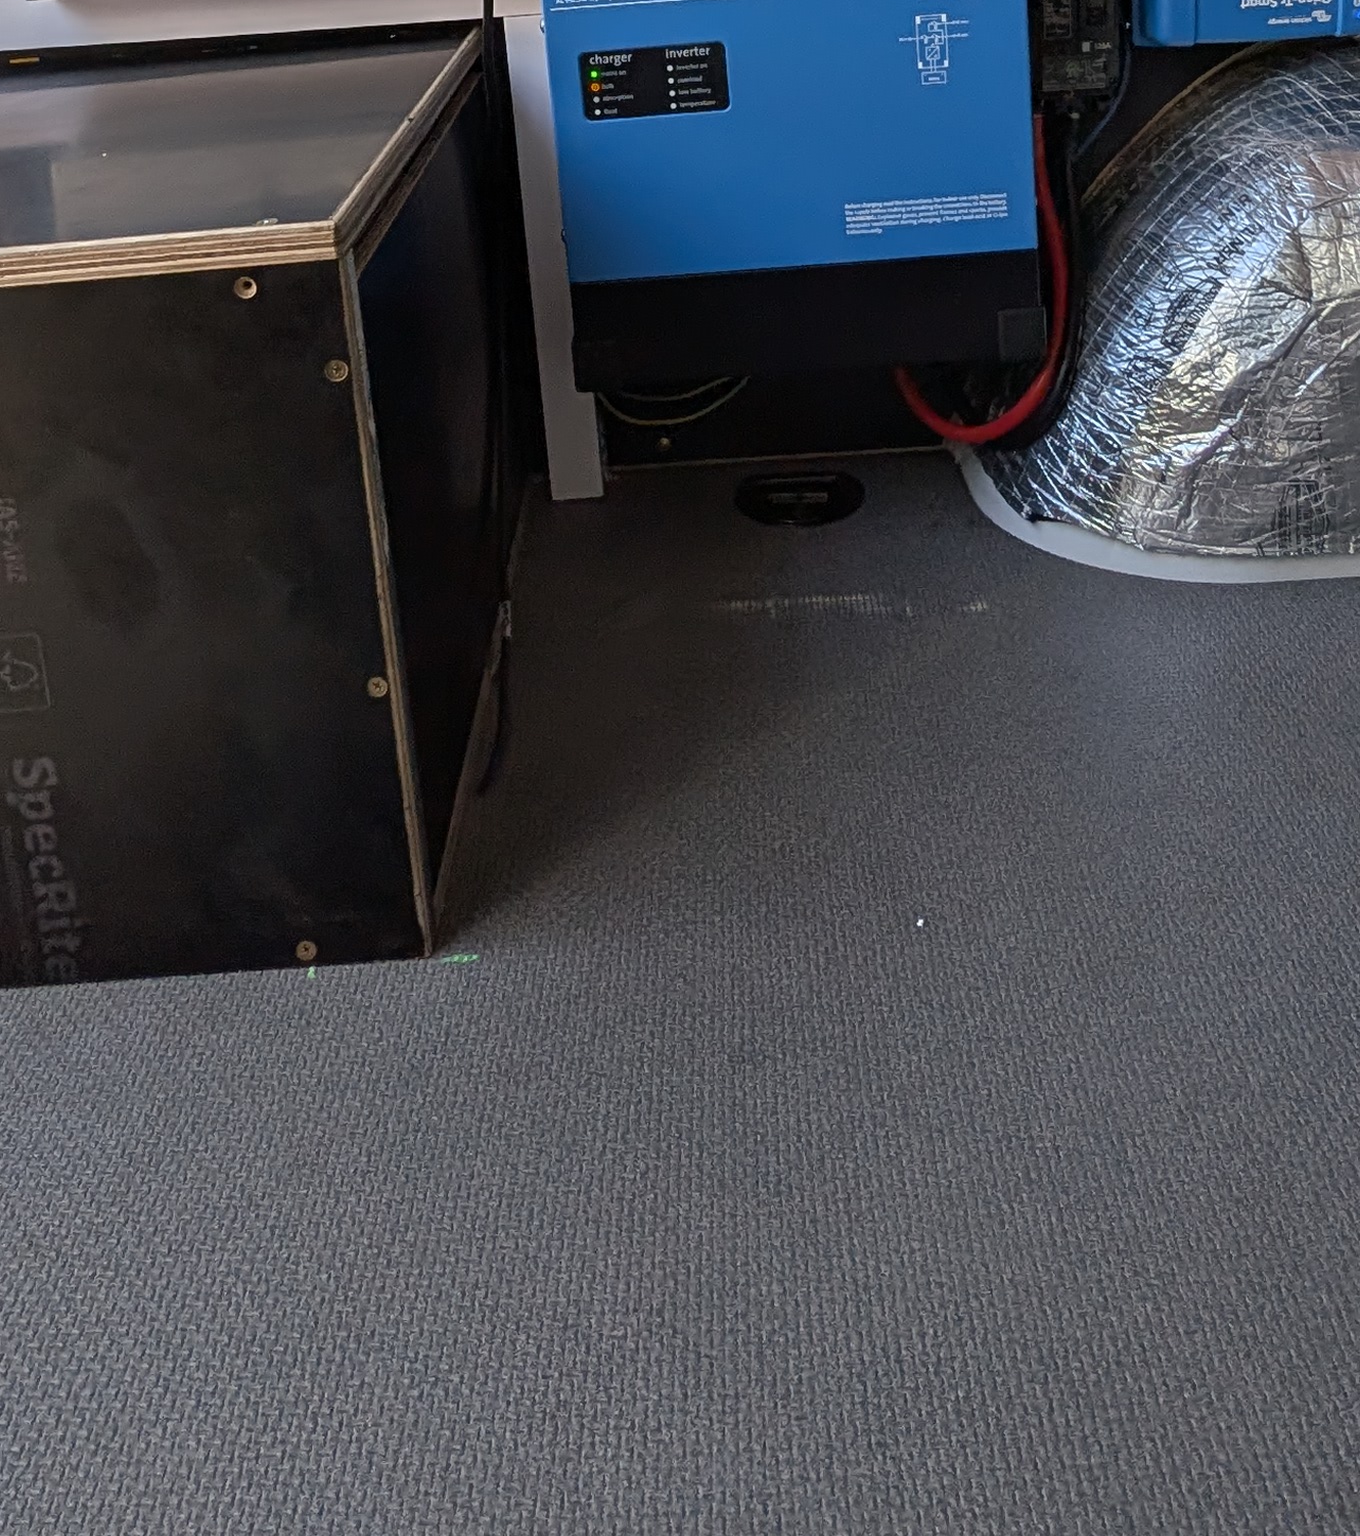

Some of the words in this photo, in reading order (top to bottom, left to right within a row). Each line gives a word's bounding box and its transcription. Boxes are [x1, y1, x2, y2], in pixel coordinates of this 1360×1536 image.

[589, 52, 633, 66] charger
[665, 46, 711, 59] inverter
[6, 756, 82, 982] SpecRite
